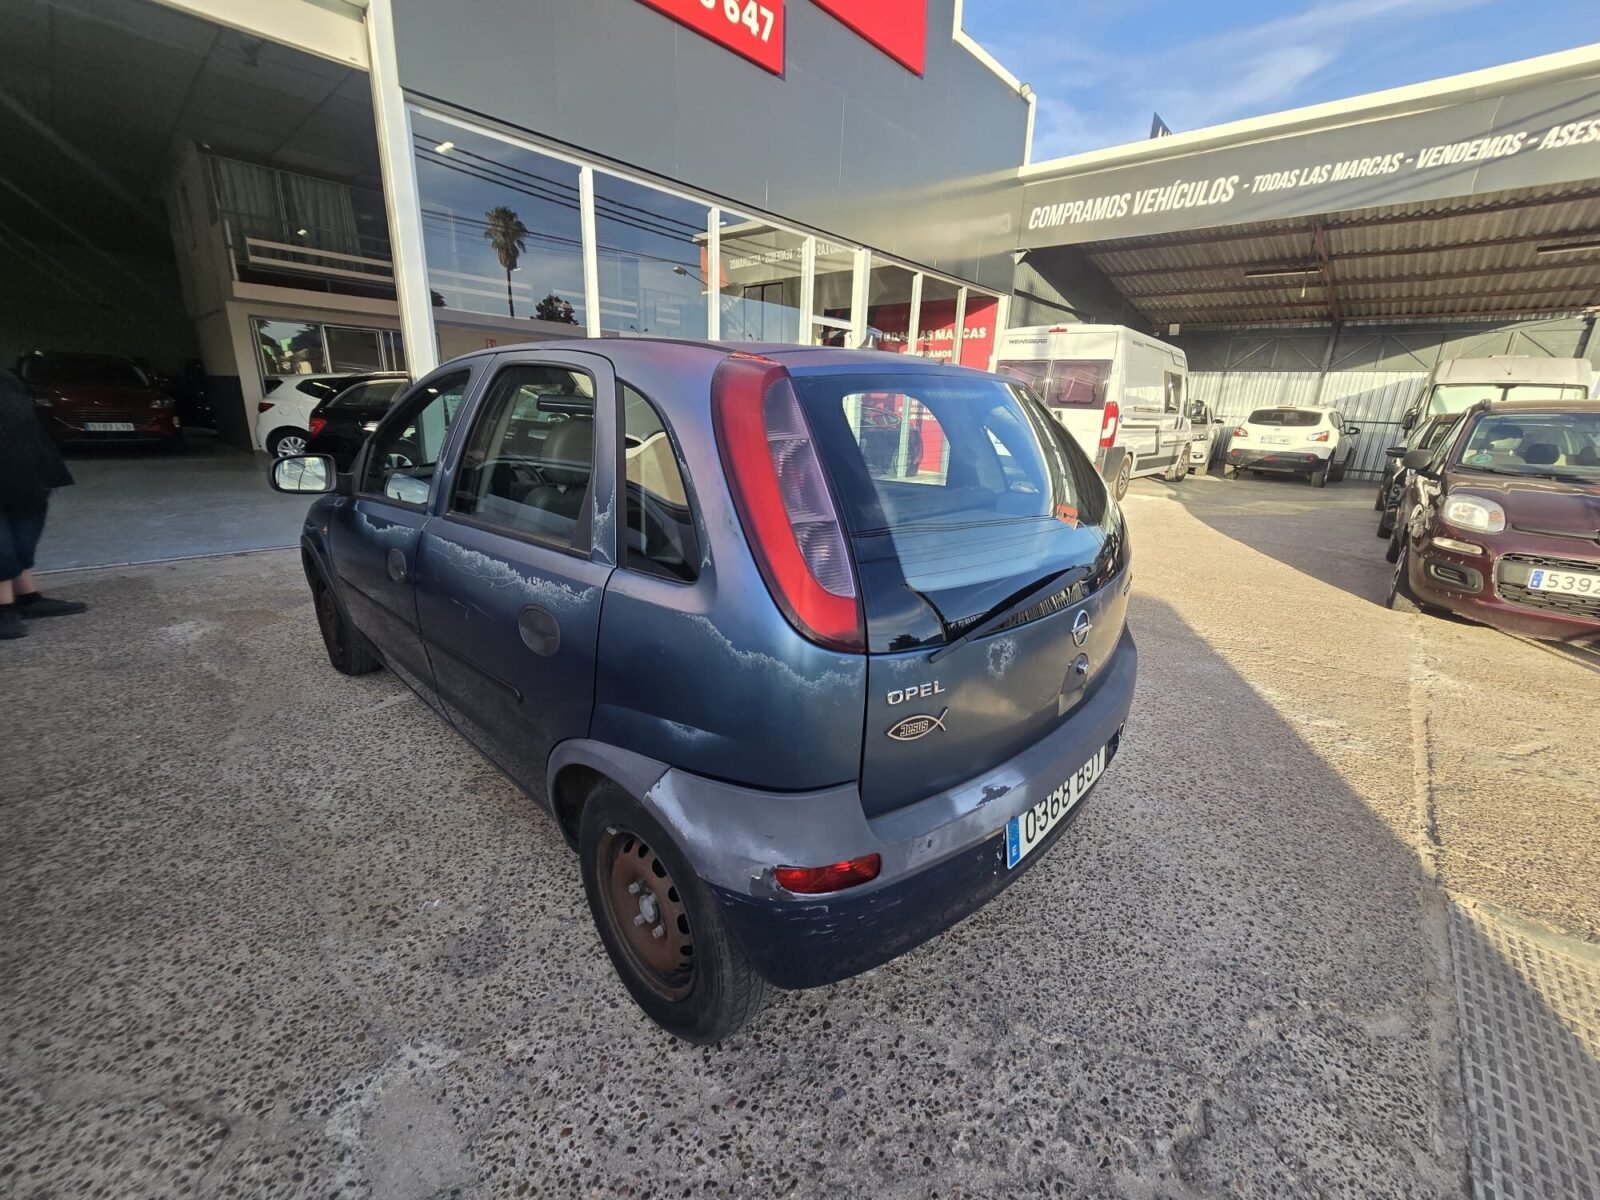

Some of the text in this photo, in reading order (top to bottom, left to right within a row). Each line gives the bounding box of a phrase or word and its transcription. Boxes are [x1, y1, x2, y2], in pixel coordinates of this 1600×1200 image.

[723, 0, 774, 42] 647
[1028, 192, 1128, 230] COMPRAMOS
[1131, 175, 1240, 215] VEHÍCULOS
[1251, 169, 1300, 194] TODAS
[1299, 164, 1330, 186] LAS
[1330, 153, 1404, 182] MARCAS
[1416, 131, 1527, 170] VENDEMOS
[1536, 119, 1600, 152] ASES
[935, 327, 987, 340] MACAS
[887, 680, 945, 705] OPEL
[1025, 779, 1071, 844] 0368
